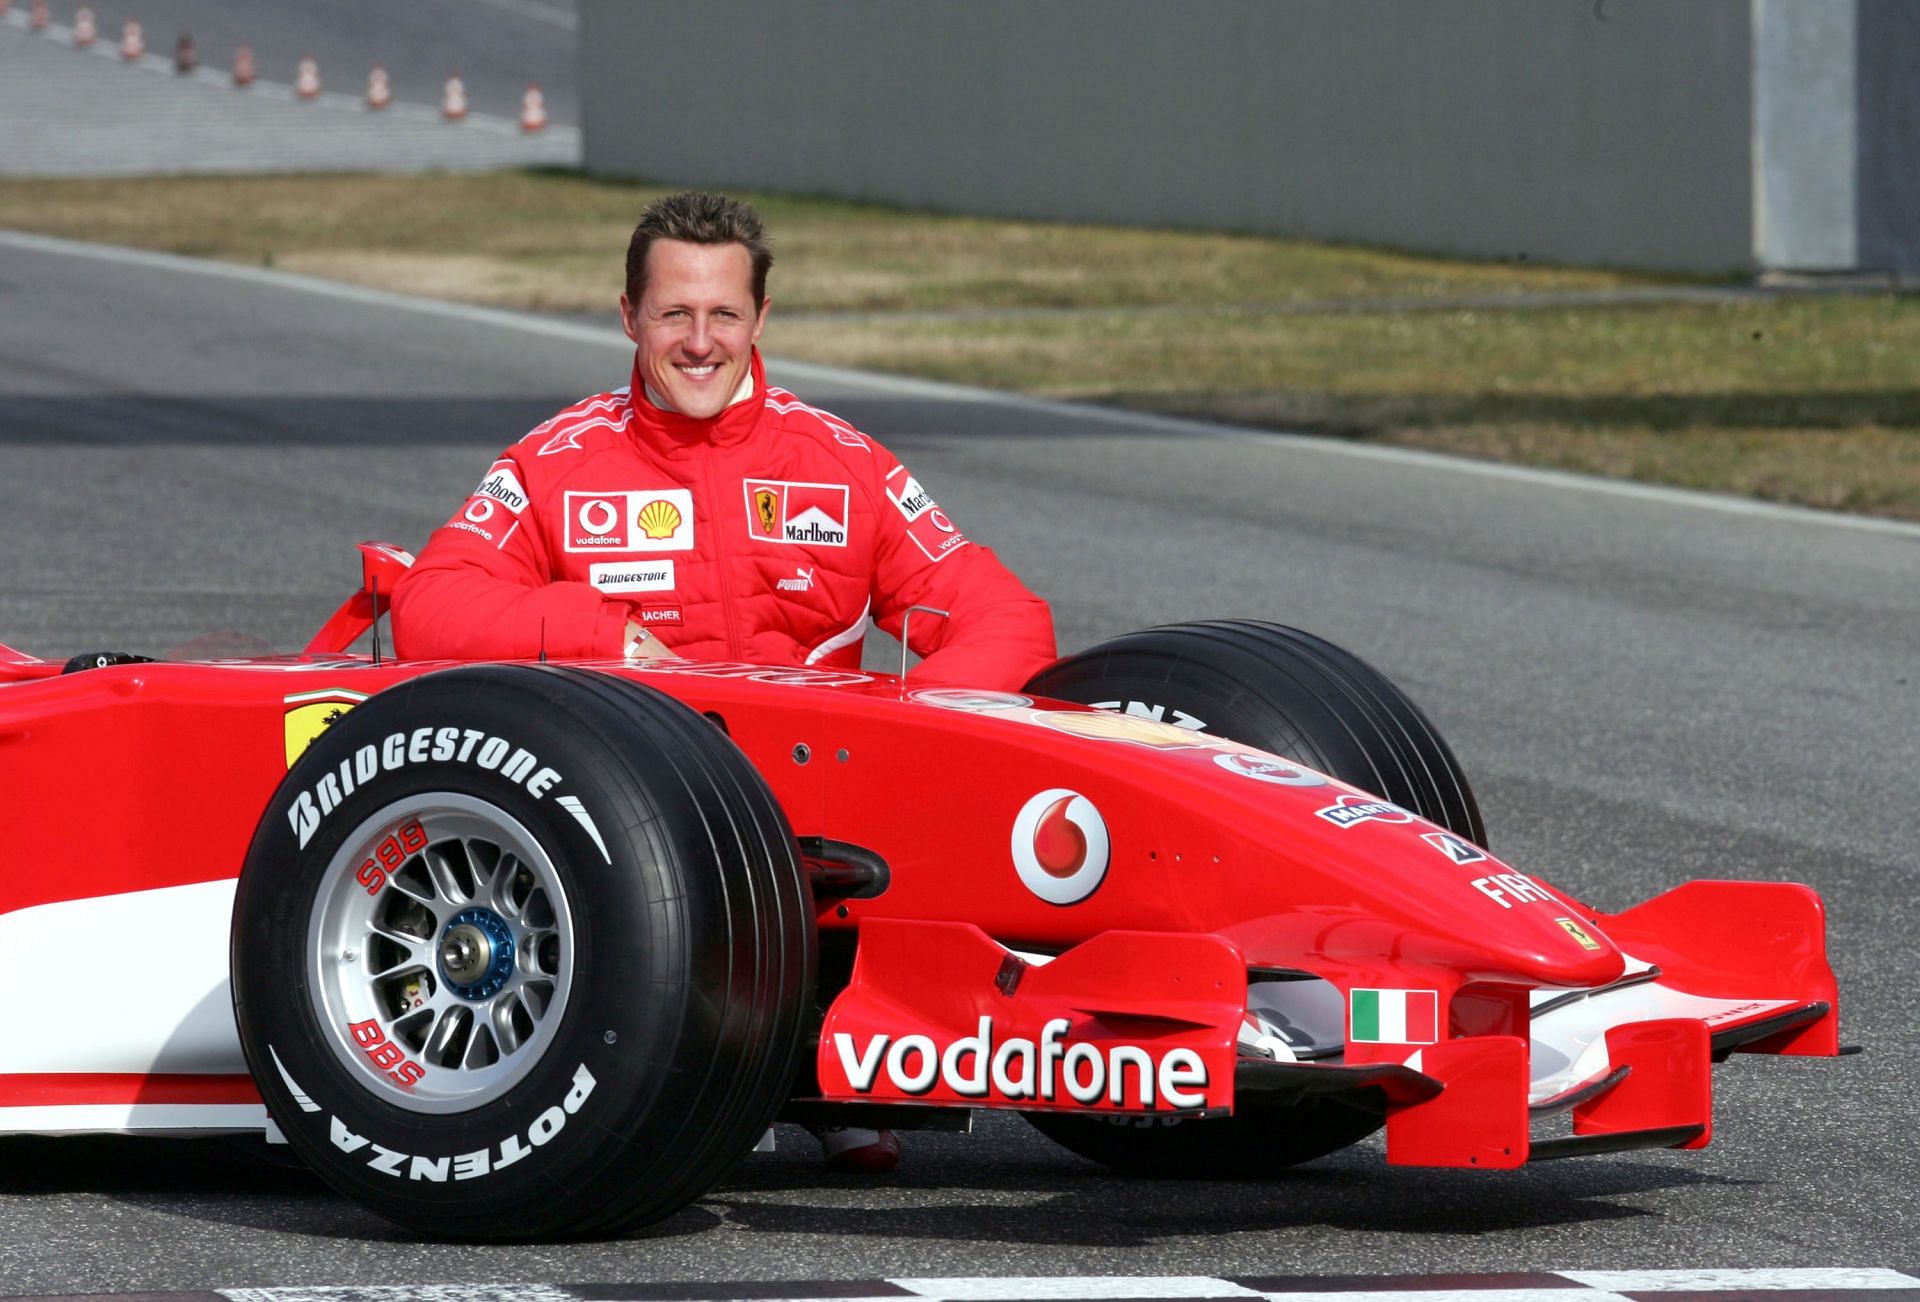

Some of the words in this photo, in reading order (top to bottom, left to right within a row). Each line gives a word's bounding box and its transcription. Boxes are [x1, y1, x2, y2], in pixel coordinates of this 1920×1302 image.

[576, 535, 622, 545] vodafone
[785, 522, 844, 544] Marlboro
[597, 571, 668, 585] BRIDGESTONE
[776, 578, 809, 592] PUMA
[287, 727, 563, 851] BRIDGESTONE
[356, 818, 429, 897] BBS
[347, 1018, 426, 1088] BBS
[833, 1015, 1207, 1108] vodafone
[329, 1062, 598, 1183] POTENZA
